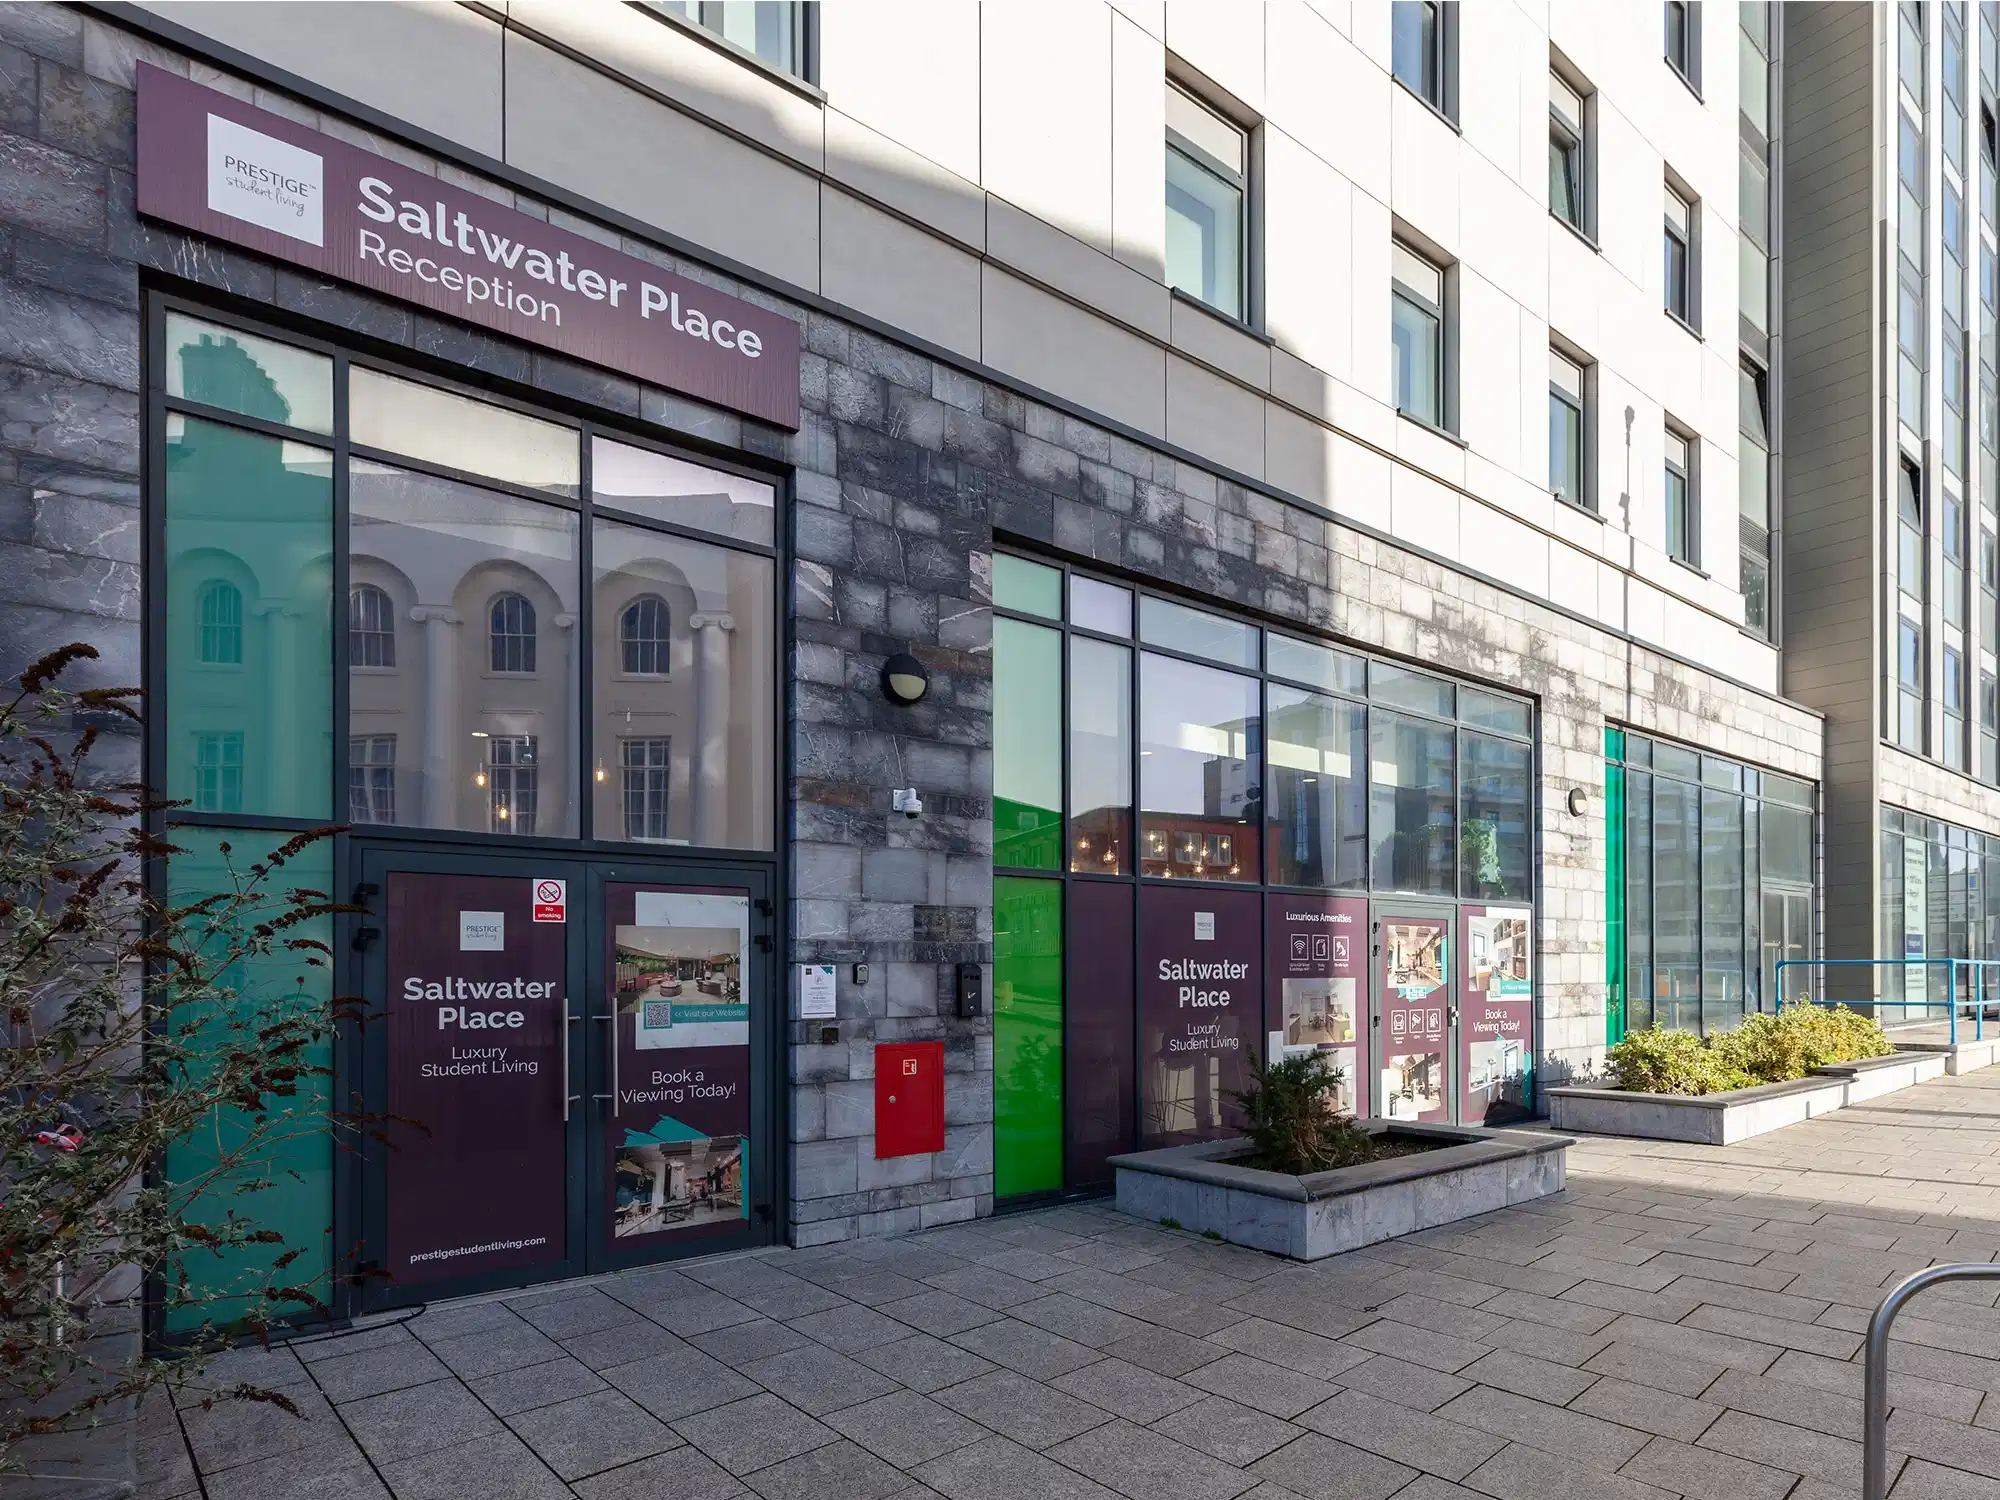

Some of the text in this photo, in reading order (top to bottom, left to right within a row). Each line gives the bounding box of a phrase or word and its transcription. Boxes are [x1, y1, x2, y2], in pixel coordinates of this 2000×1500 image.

[225, 175, 305, 217] student living
[357, 176, 763, 358] Saltwater Place
[359, 228, 561, 327] Reception
[1286, 912, 1352, 924] Luxurious Amenities
[1159, 958, 1248, 980] Saltwater
[403, 976, 556, 1001] Saltwater
[1179, 985, 1230, 1008] Place
[438, 1006, 525, 1030] Place
[683, 1009, 700, 1018] Visit
[715, 1008, 746, 1017] Website
[1485, 1009, 1507, 1020] Book a
[1187, 1023, 1220, 1037] Luxury
[1473, 1020, 1521, 1034] Viewing Today!
[1169, 1036, 1239, 1052] Student Living
[452, 1047, 508, 1061] Luxury
[421, 1060, 538, 1077] Student Living
[652, 1069, 704, 1085] Book a
[620, 1082, 736, 1104] Viewing Today!
[410, 1236, 546, 1264] prestigestudentliving.com
